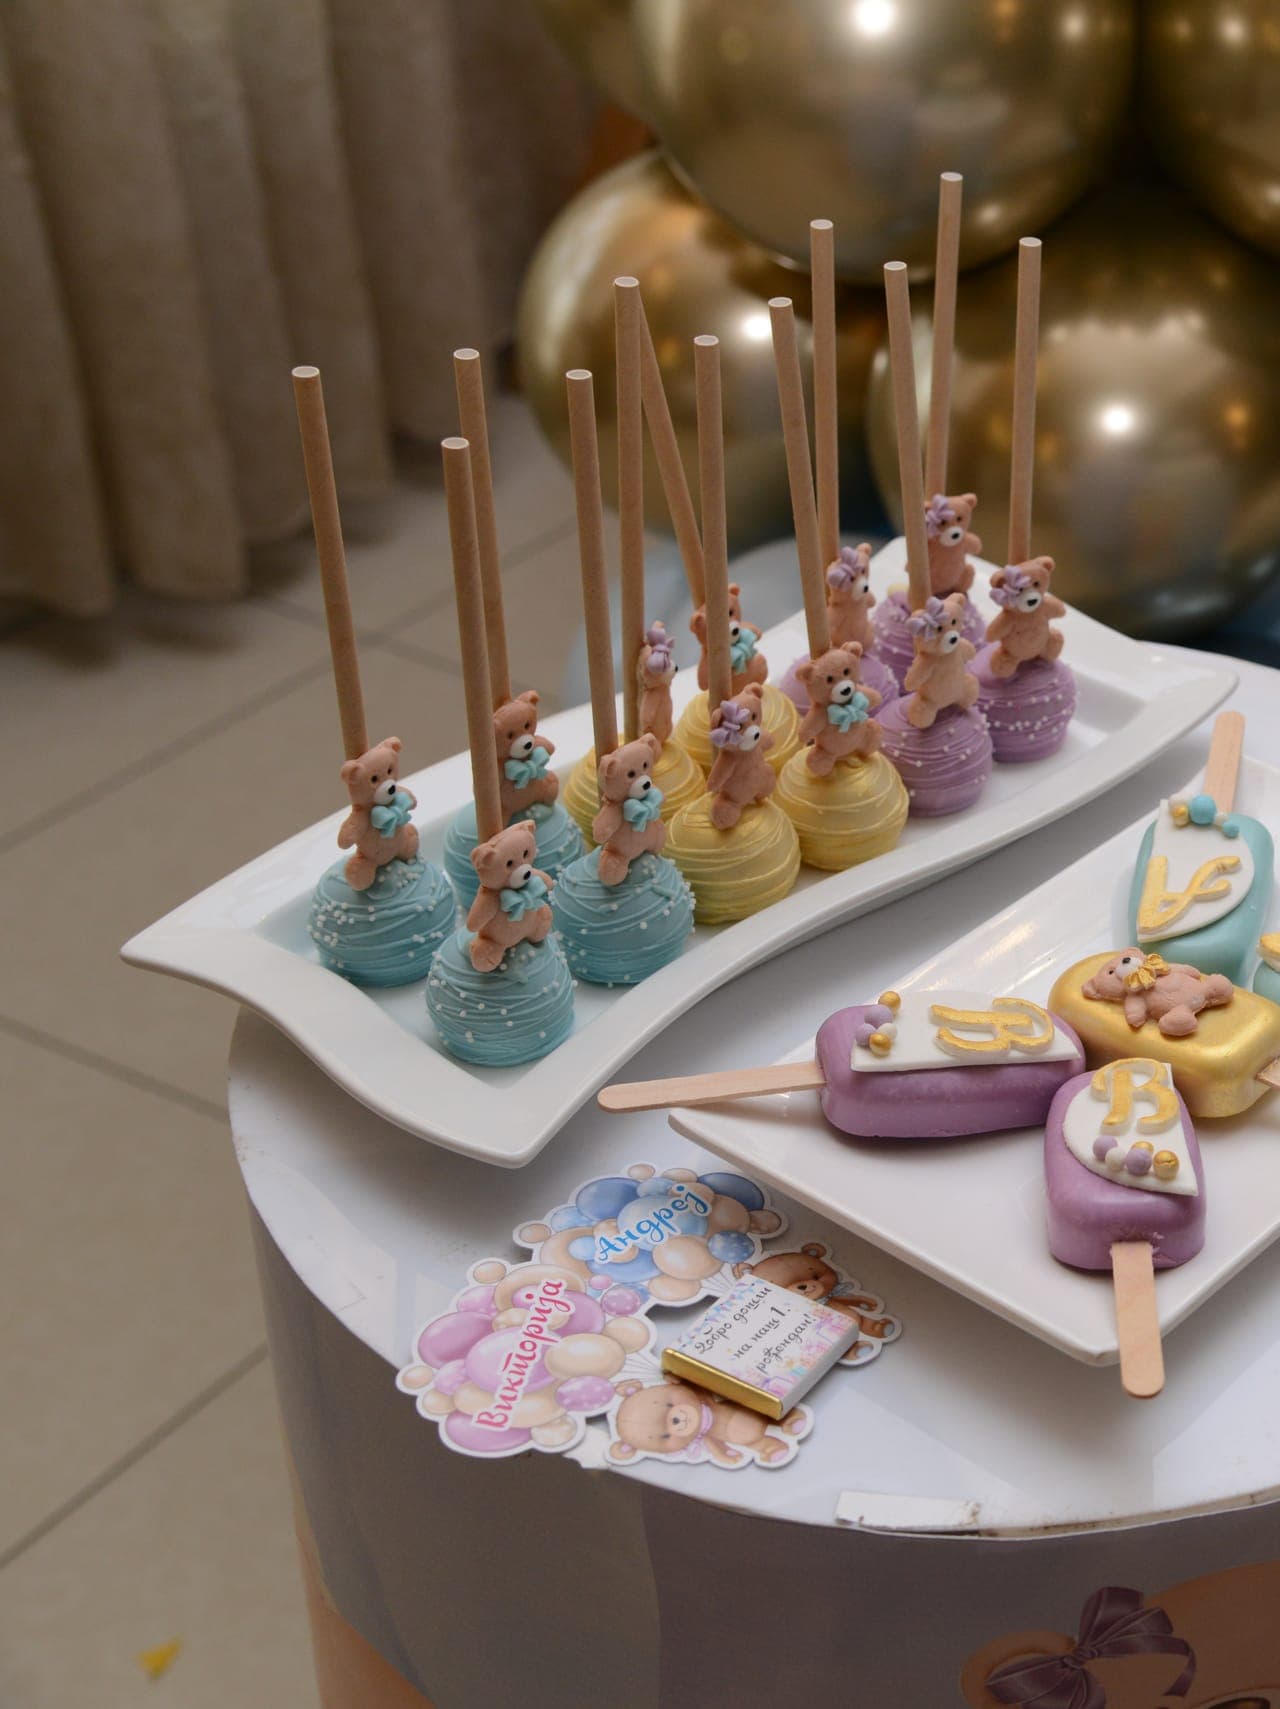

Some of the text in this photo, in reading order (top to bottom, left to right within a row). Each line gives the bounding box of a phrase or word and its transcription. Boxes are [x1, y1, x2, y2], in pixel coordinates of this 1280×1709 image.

[598, 1184, 709, 1261] Андреј
[475, 1281, 571, 1428] Викторија
[694, 1286, 772, 1354] Добро дошли
[732, 1306, 792, 1360] на наш 1.
